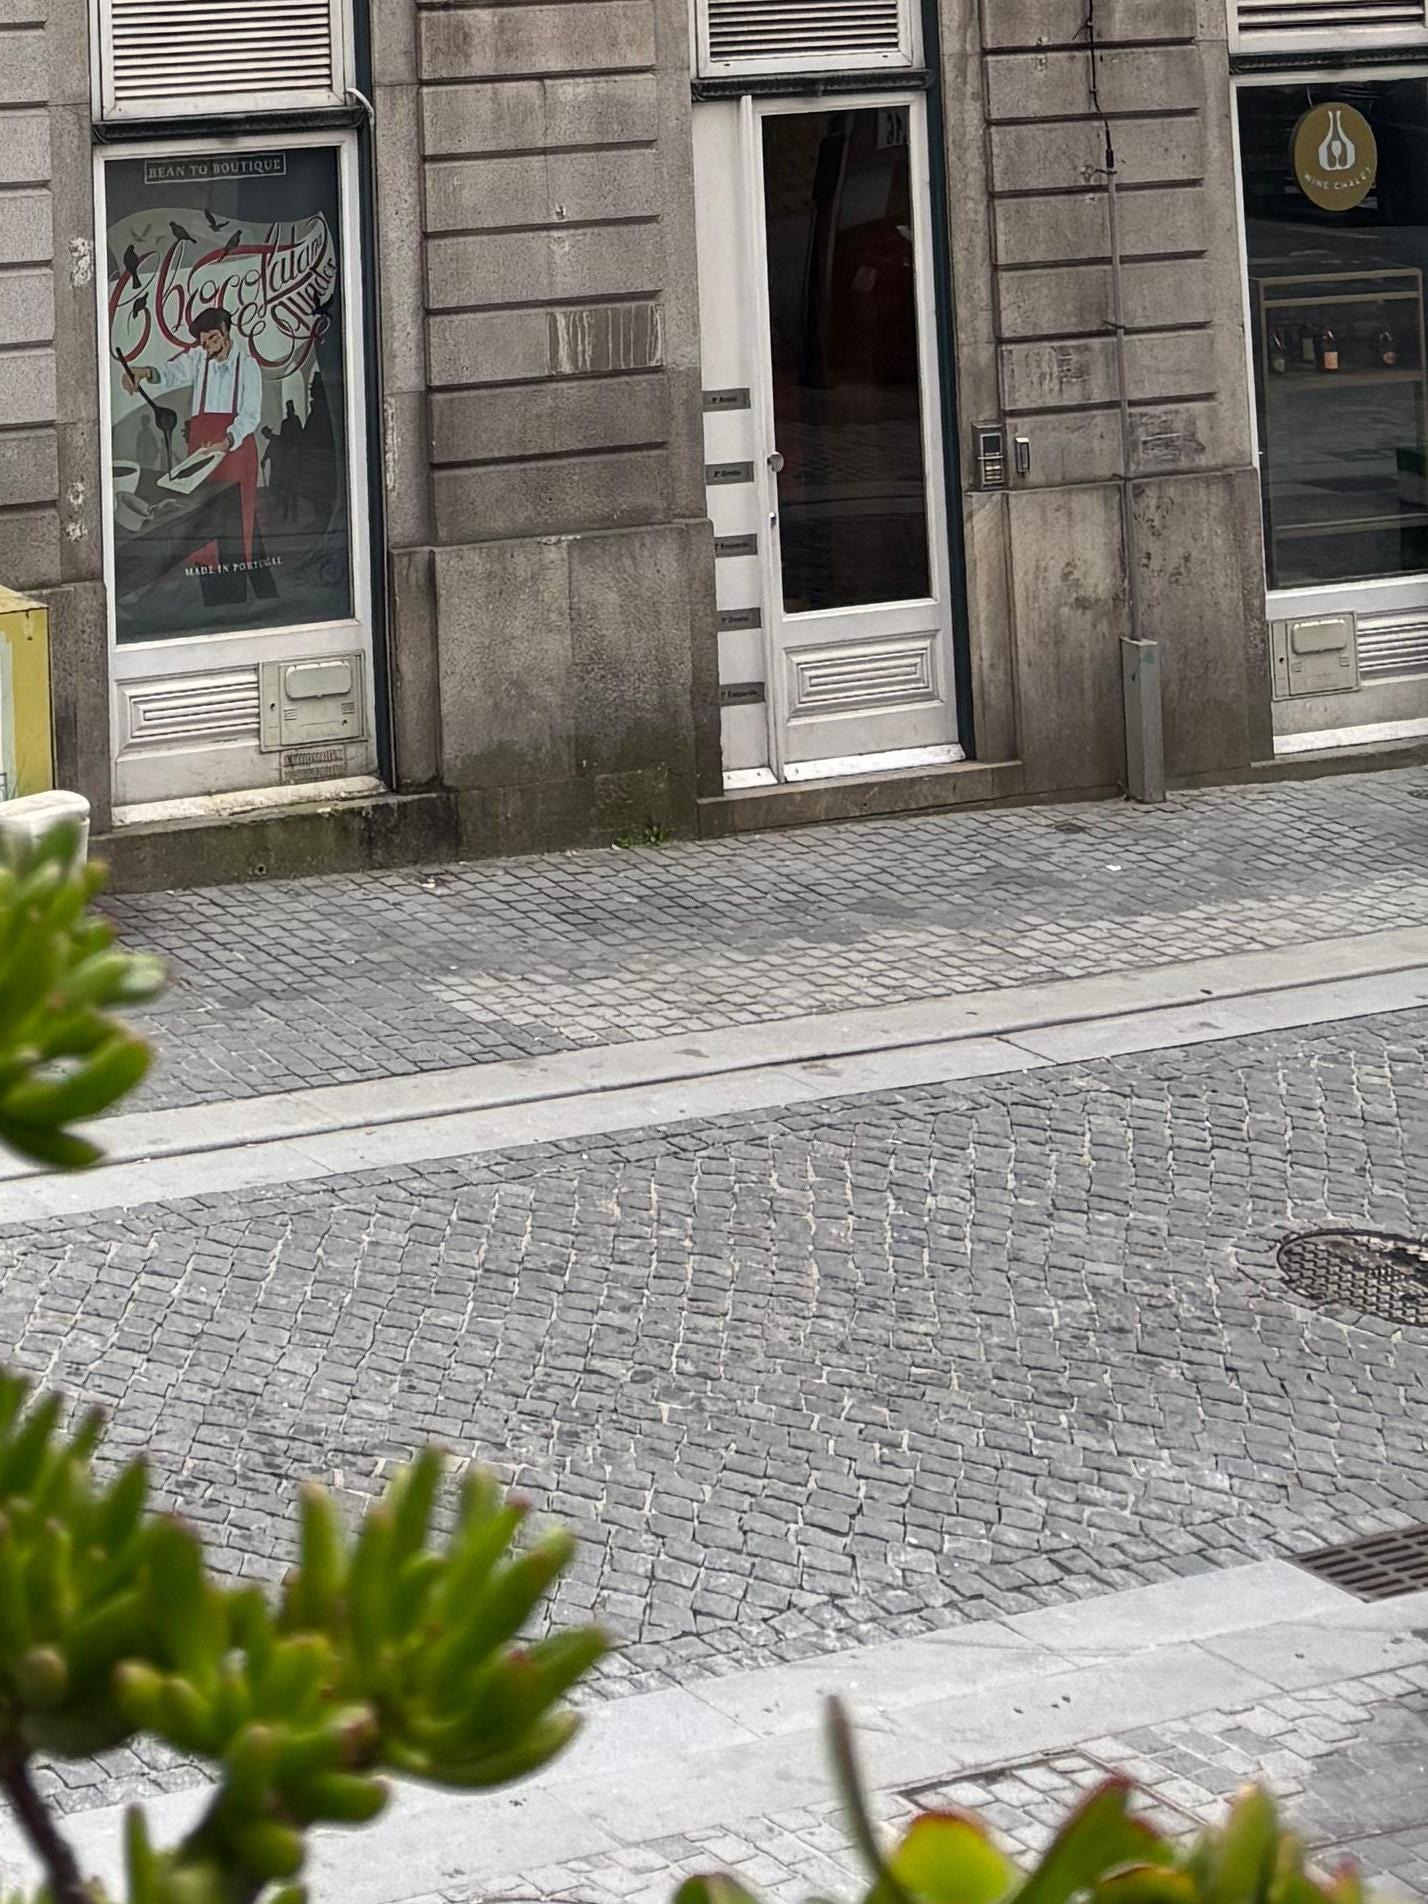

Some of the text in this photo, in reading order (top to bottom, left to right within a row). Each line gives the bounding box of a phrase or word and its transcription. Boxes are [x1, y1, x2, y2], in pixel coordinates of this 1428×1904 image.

[149, 158, 281, 179] BEAN TO BOUTIQUE
[185, 566, 214, 576] MADE
[217, 564, 229, 573] IN
